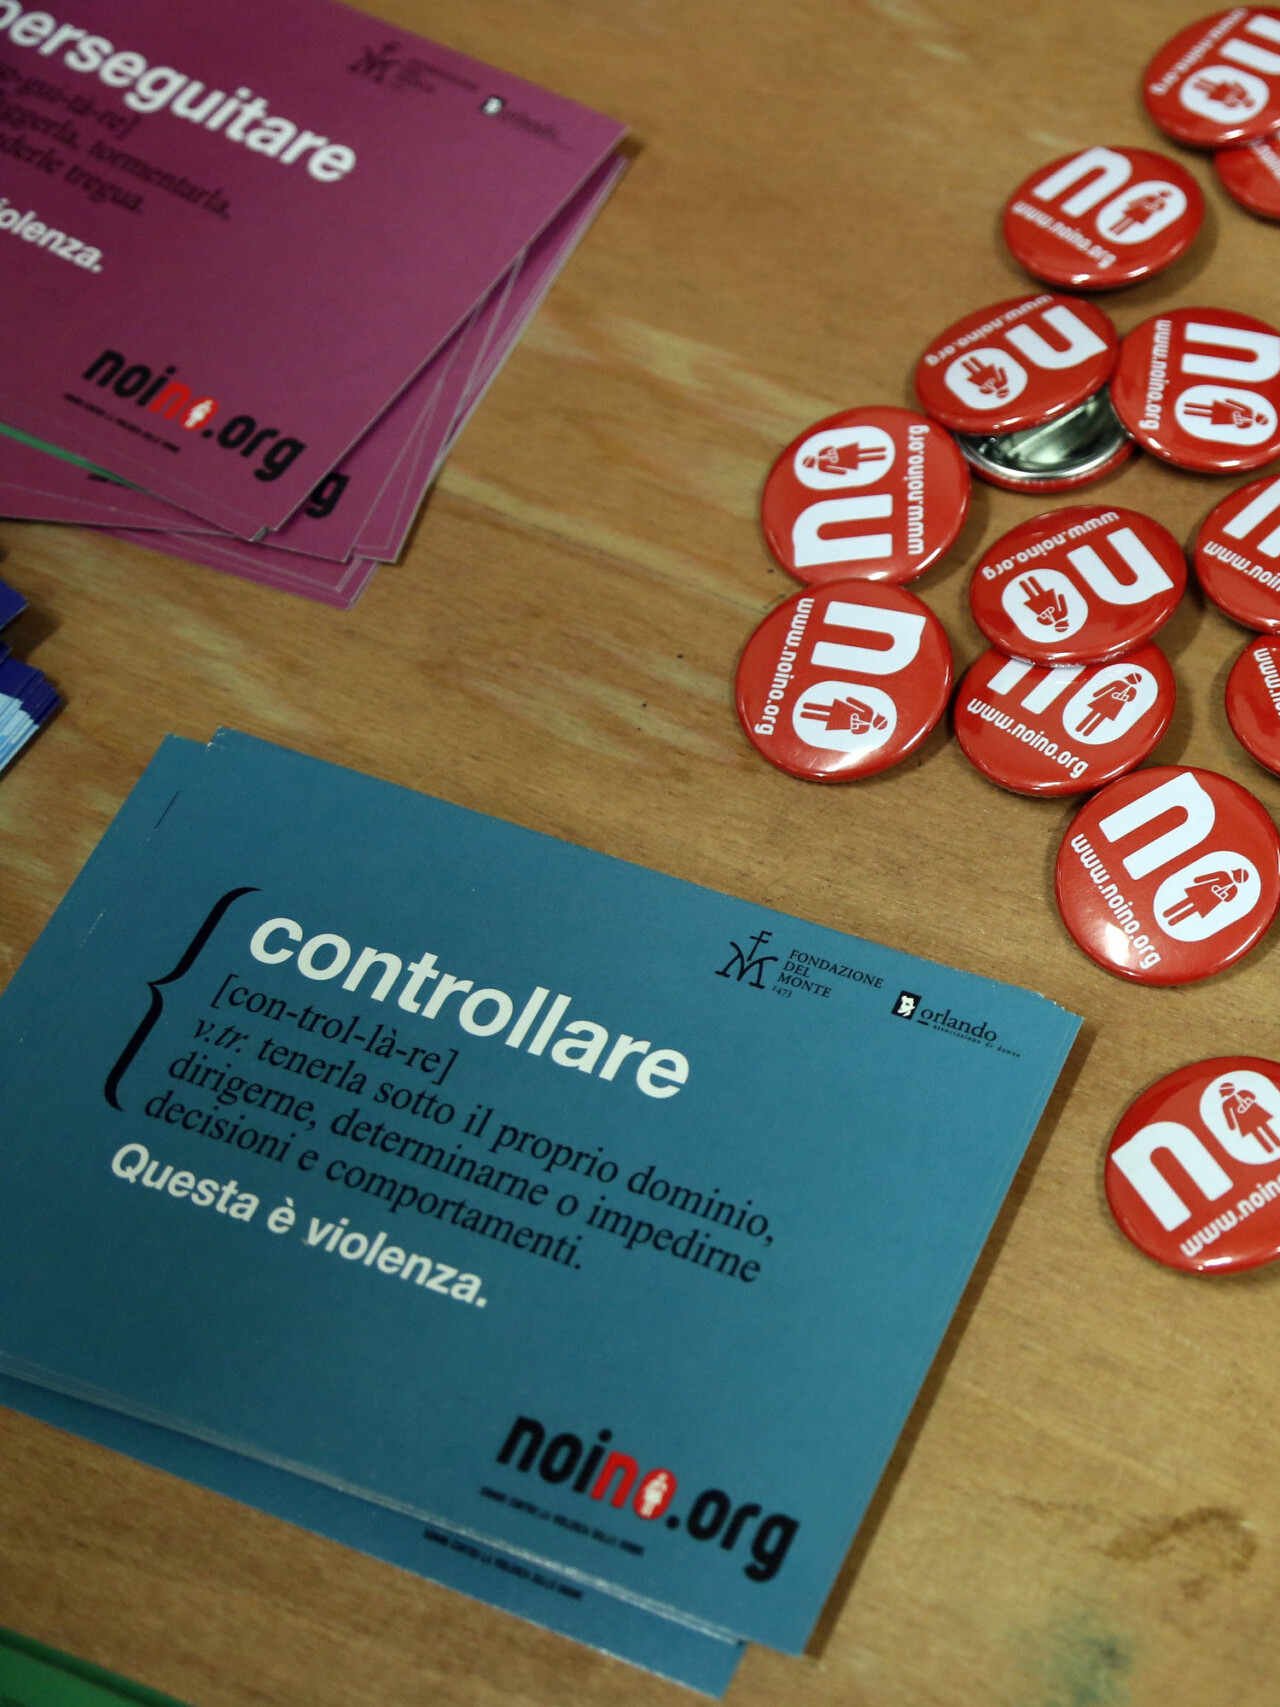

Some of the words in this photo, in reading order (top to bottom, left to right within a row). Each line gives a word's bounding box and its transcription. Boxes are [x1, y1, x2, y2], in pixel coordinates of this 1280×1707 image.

[1032, 146, 1187, 244] no
[925, 294, 1053, 366] www.noino.org
[944, 305, 1108, 409] no
[1139, 320, 1172, 430] www.noino.org
[82, 349, 306, 482] noino.org
[792, 425, 895, 568] no
[903, 425, 930, 555] www.noino.org
[982, 512, 1120, 580] www.noino.org
[1002, 527, 1174, 643] no
[755, 598, 815, 735] www.noino.org
[792, 601, 927, 753] no
[967, 697, 1089, 779] www.noino.org
[1070, 833, 1161, 970] www.noino.org
[1099, 771, 1261, 942] no
[250, 917, 690, 1099] controllare
[777, 972, 832, 998] MONTE
[783, 961, 809, 978] DEL
[789, 949, 884, 989] FONDAZIONE
[921, 1009, 997, 1042] orlando
[144, 1090, 296, 1163] decisioni
[297, 1149, 319, 1171] e
[326, 1159, 582, 1270] comportamenti.
[168, 1052, 316, 1130] dirigerne,
[331, 1108, 549, 1206] determinarne
[556, 1193, 579, 1217] o
[586, 1195, 761, 1283] impedirne
[193, 1019, 250, 1054] v.tr.
[257, 1037, 367, 1095] tenerla
[373, 1081, 455, 1125] sotto
[461, 1104, 494, 1137] il
[489, 1124, 619, 1184] proprio
[627, 1165, 774, 1247] dominio,
[111, 1142, 260, 1222] Questa
[267, 1197, 295, 1234] è
[307, 1217, 488, 1308] violenza.
[496, 1414, 799, 1583] noino.org
